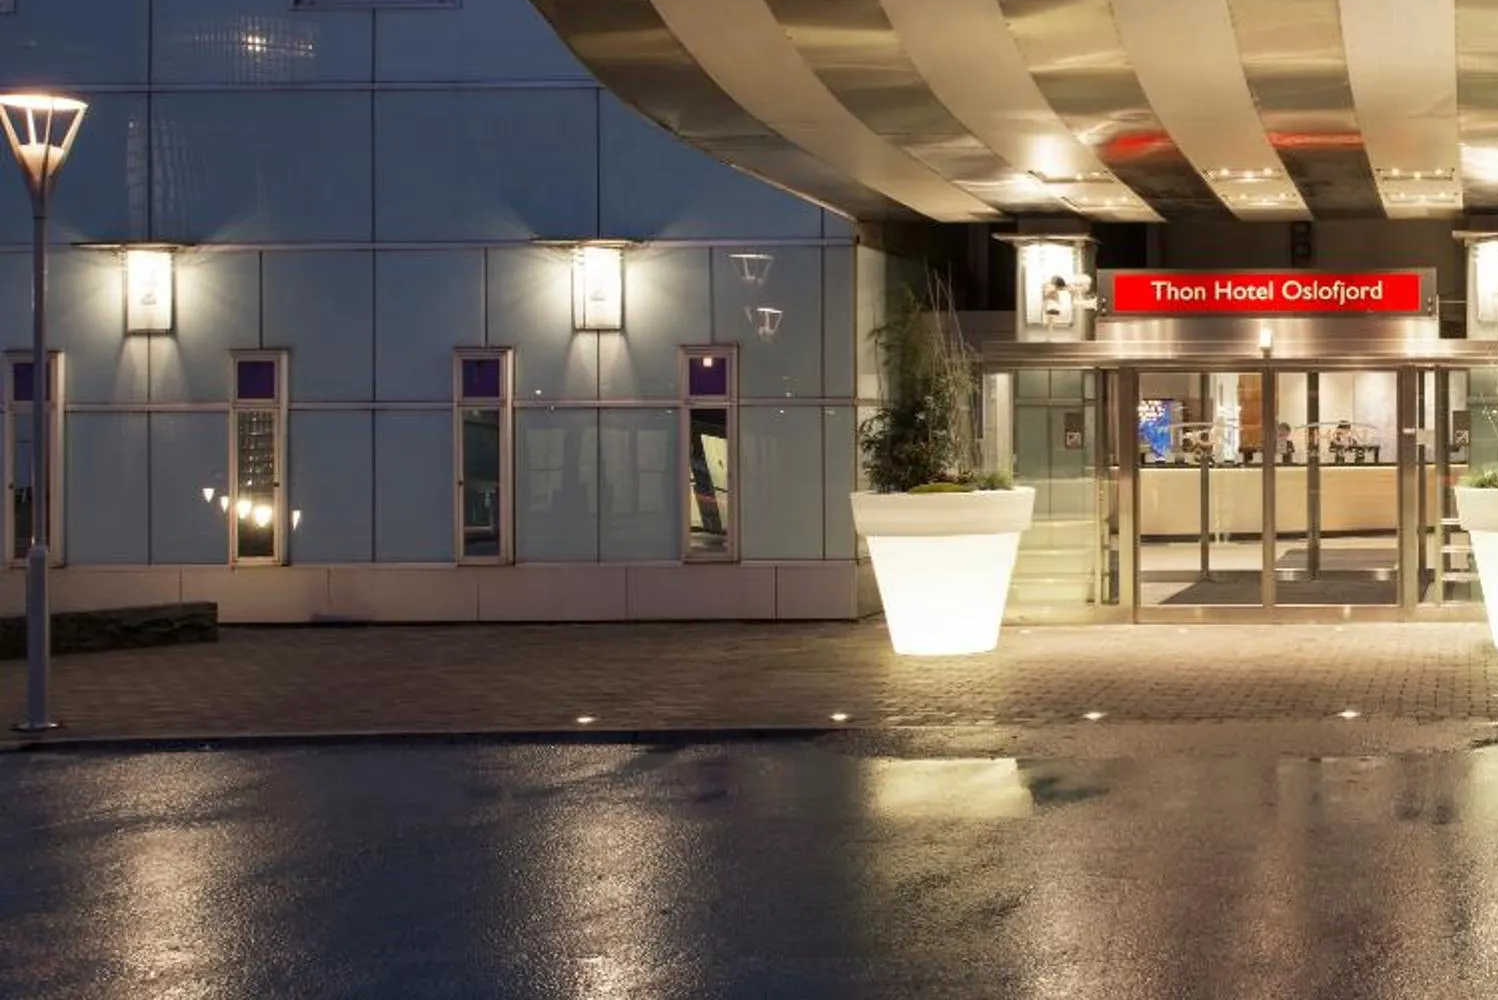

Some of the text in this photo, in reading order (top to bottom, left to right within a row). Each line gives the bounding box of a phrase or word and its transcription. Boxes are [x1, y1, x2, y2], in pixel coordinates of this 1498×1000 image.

[1151, 280, 1383, 306] Thon Hotel Oslofjord
